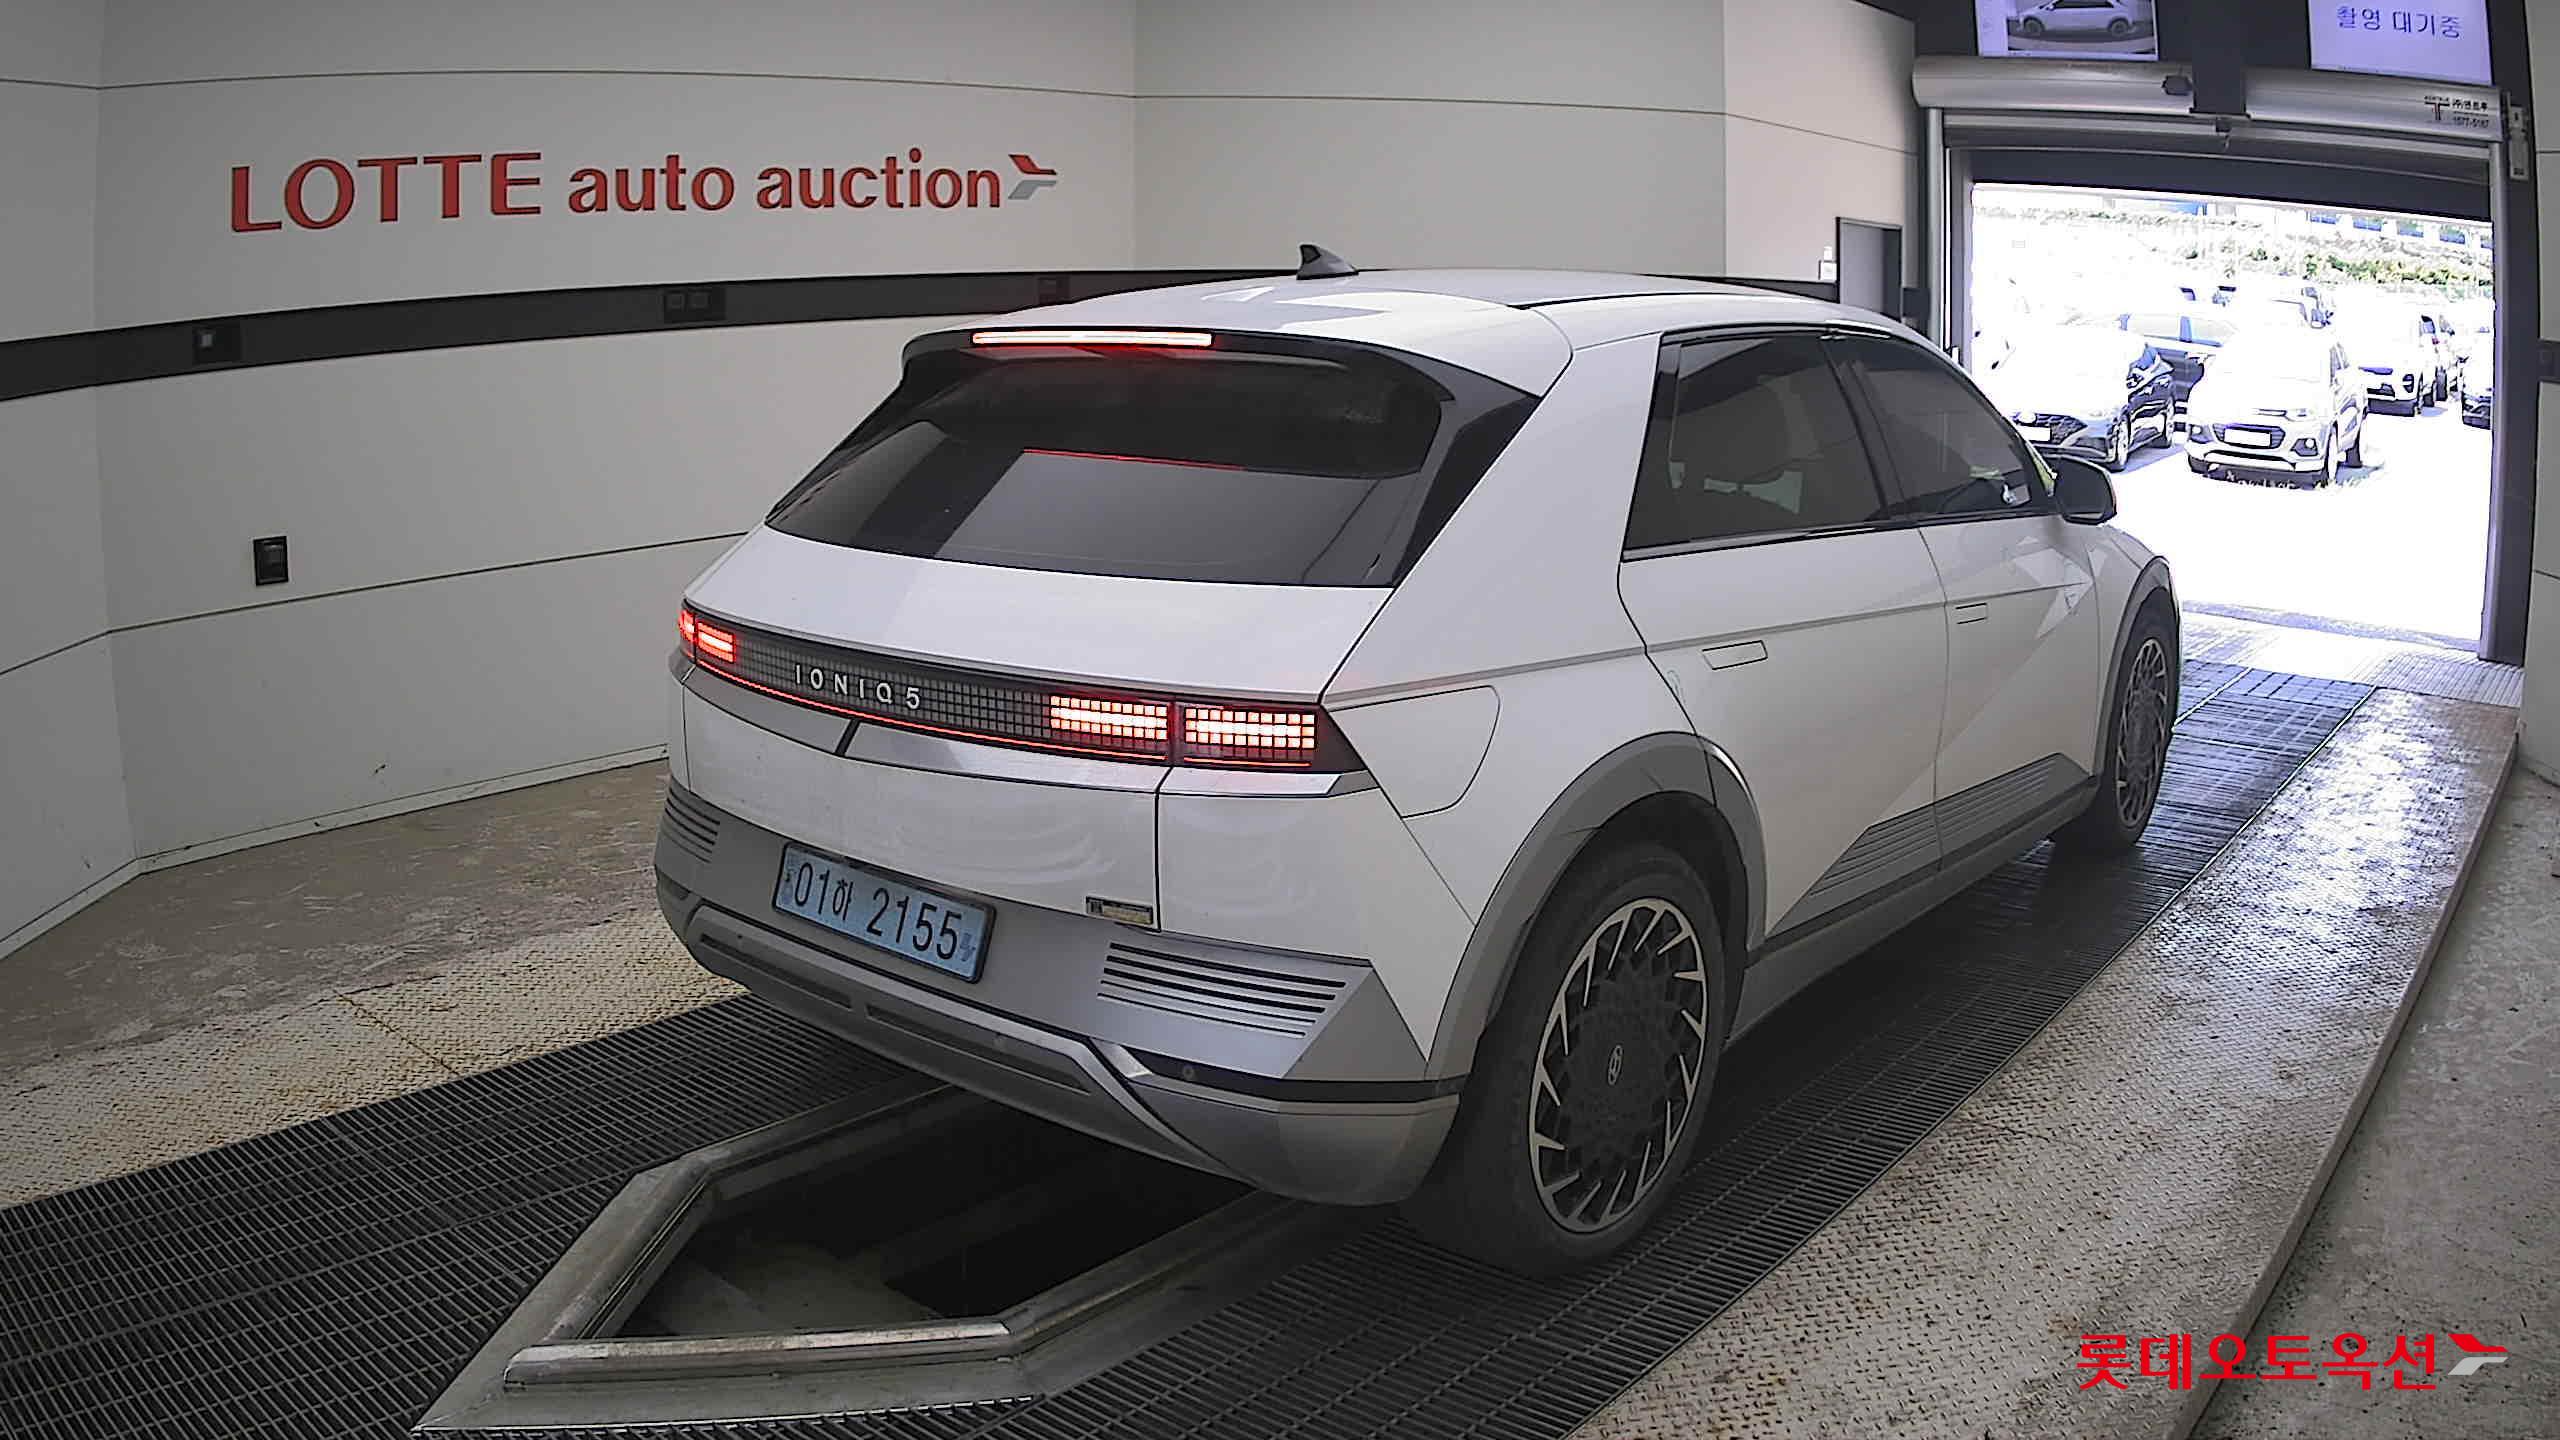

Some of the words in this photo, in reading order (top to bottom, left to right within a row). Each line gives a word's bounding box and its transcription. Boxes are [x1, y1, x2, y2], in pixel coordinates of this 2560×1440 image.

[2337, 5, 2381, 31] 촬영
[2392, 10, 2460, 39] 대기중
[231, 152, 542, 233] LOTTE
[568, 154, 735, 213] auto
[756, 147, 1001, 209] auction
[794, 664, 893, 704] IONIQ
[906, 686, 920, 710] 5
[794, 862, 854, 921] 01하
[866, 887, 962, 960] 2155
